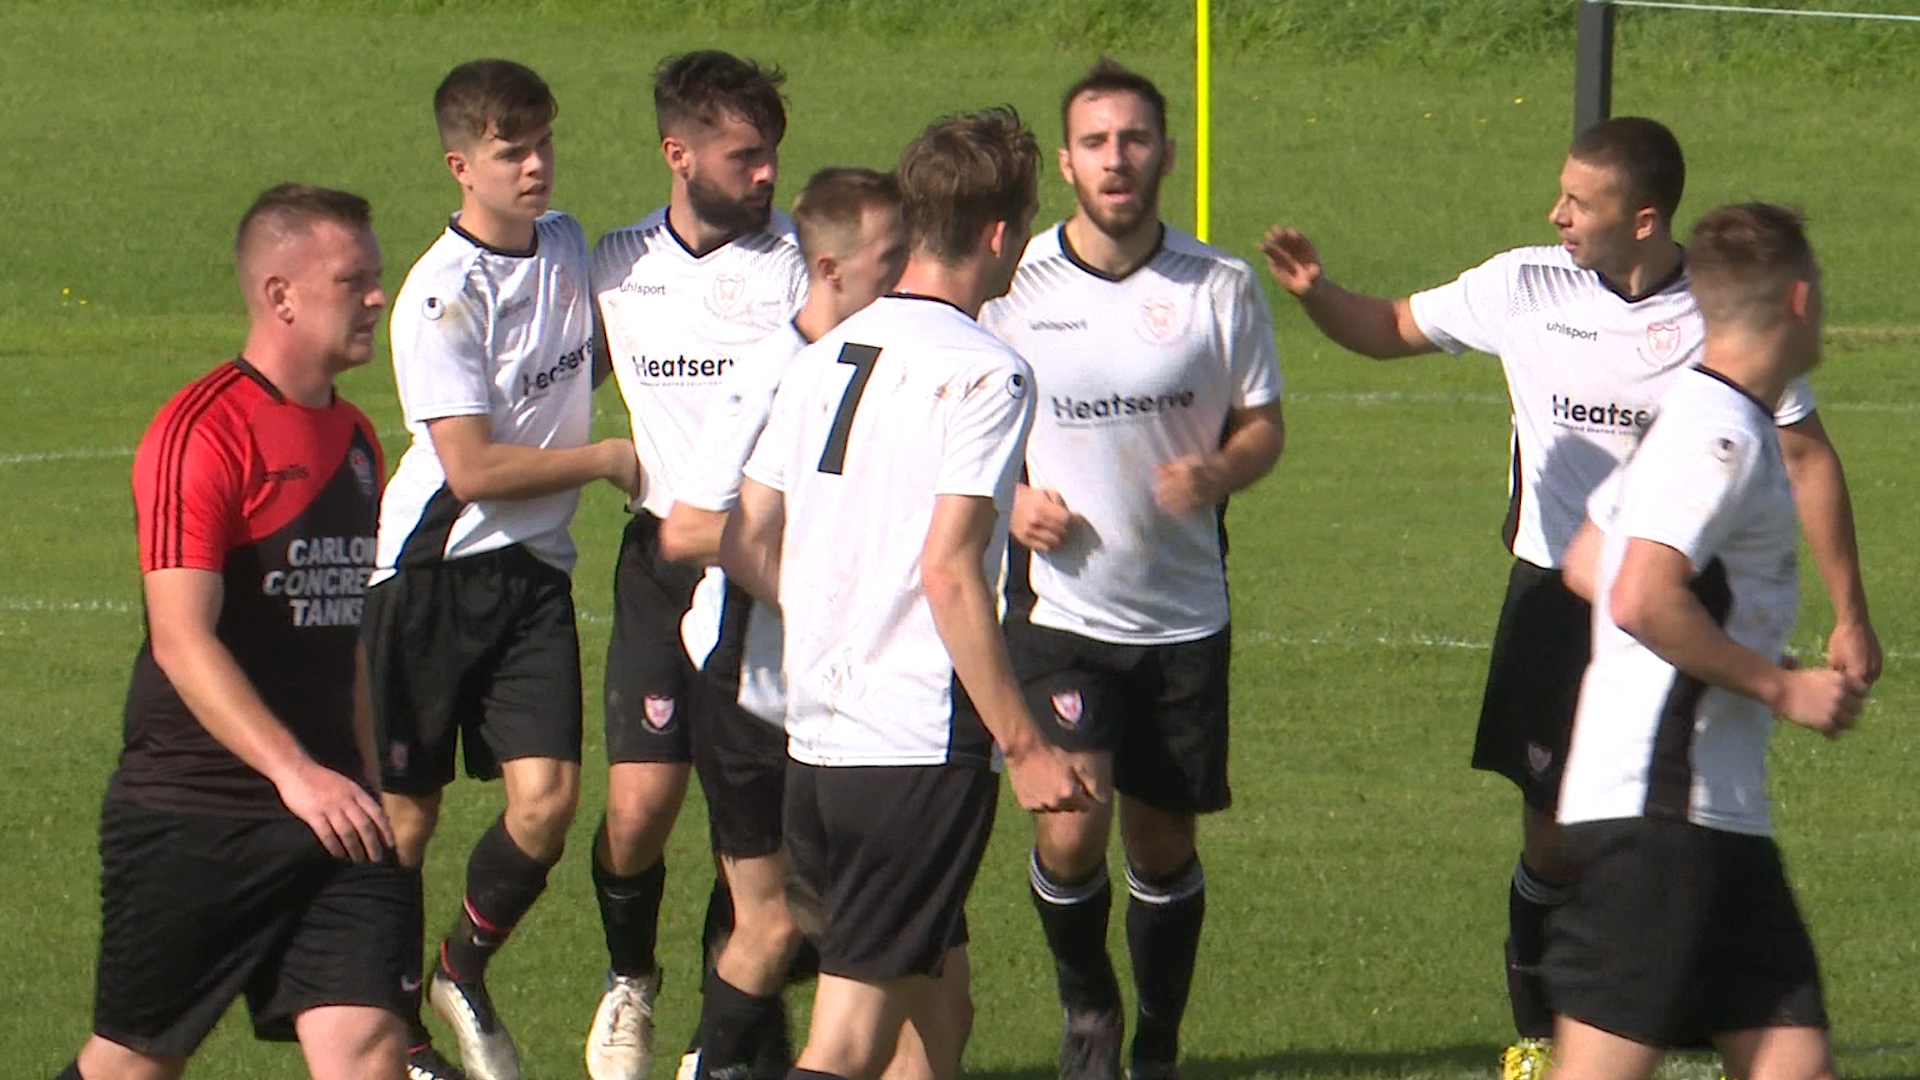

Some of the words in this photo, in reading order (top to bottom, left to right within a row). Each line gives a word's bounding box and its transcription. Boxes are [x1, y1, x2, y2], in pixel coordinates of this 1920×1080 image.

[1546, 321, 1598, 341] uhlsport
[631, 354, 734, 377] Heatser
[1553, 394, 1652, 427] Heatse
[262, 567, 373, 596] CONCRE
